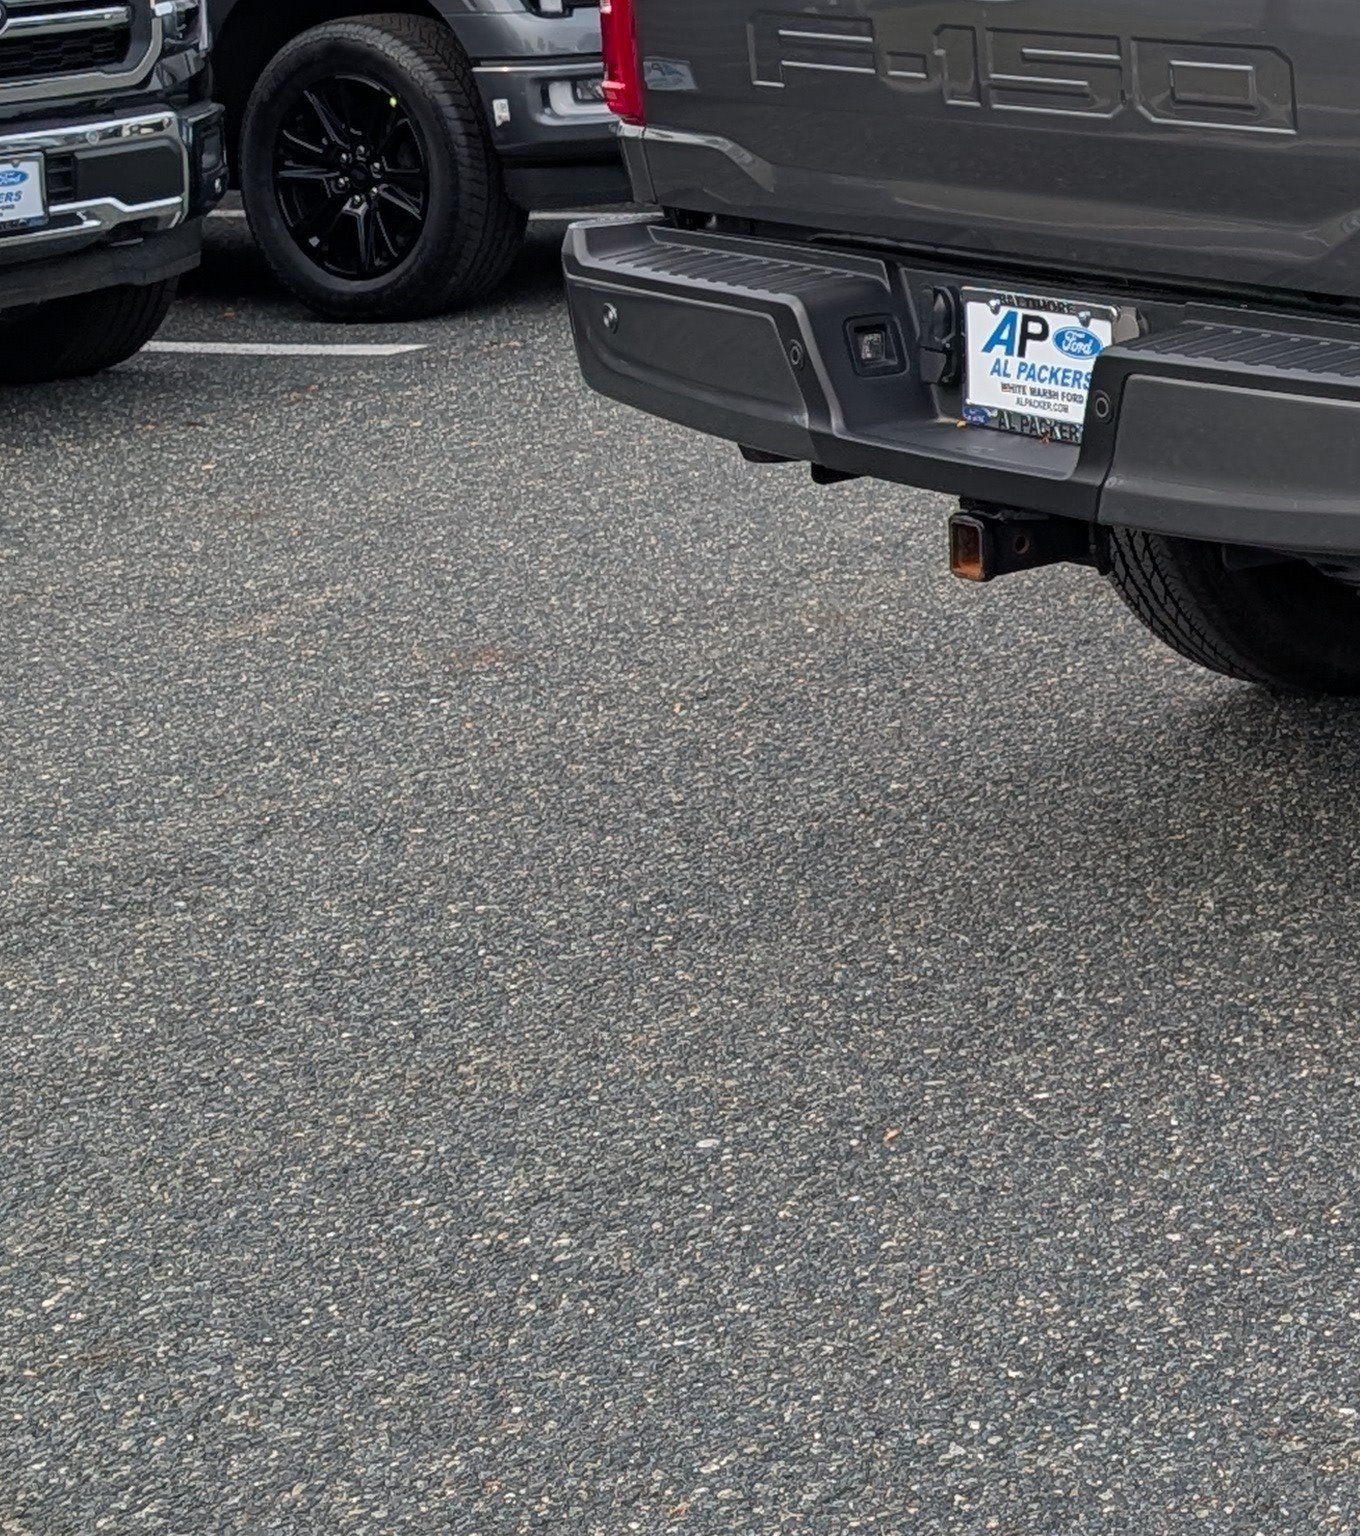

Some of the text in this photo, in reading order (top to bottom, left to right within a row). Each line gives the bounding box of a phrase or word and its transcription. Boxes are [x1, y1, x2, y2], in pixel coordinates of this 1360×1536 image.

[747, 10, 1297, 134] F-150
[982, 309, 1049, 358] AP
[1061, 330, 1095, 356] Ford
[990, 358, 1091, 390] AL PACKERS
[1001, 382, 1027, 396] WHITE
[1060, 392, 1084, 404] FORD
